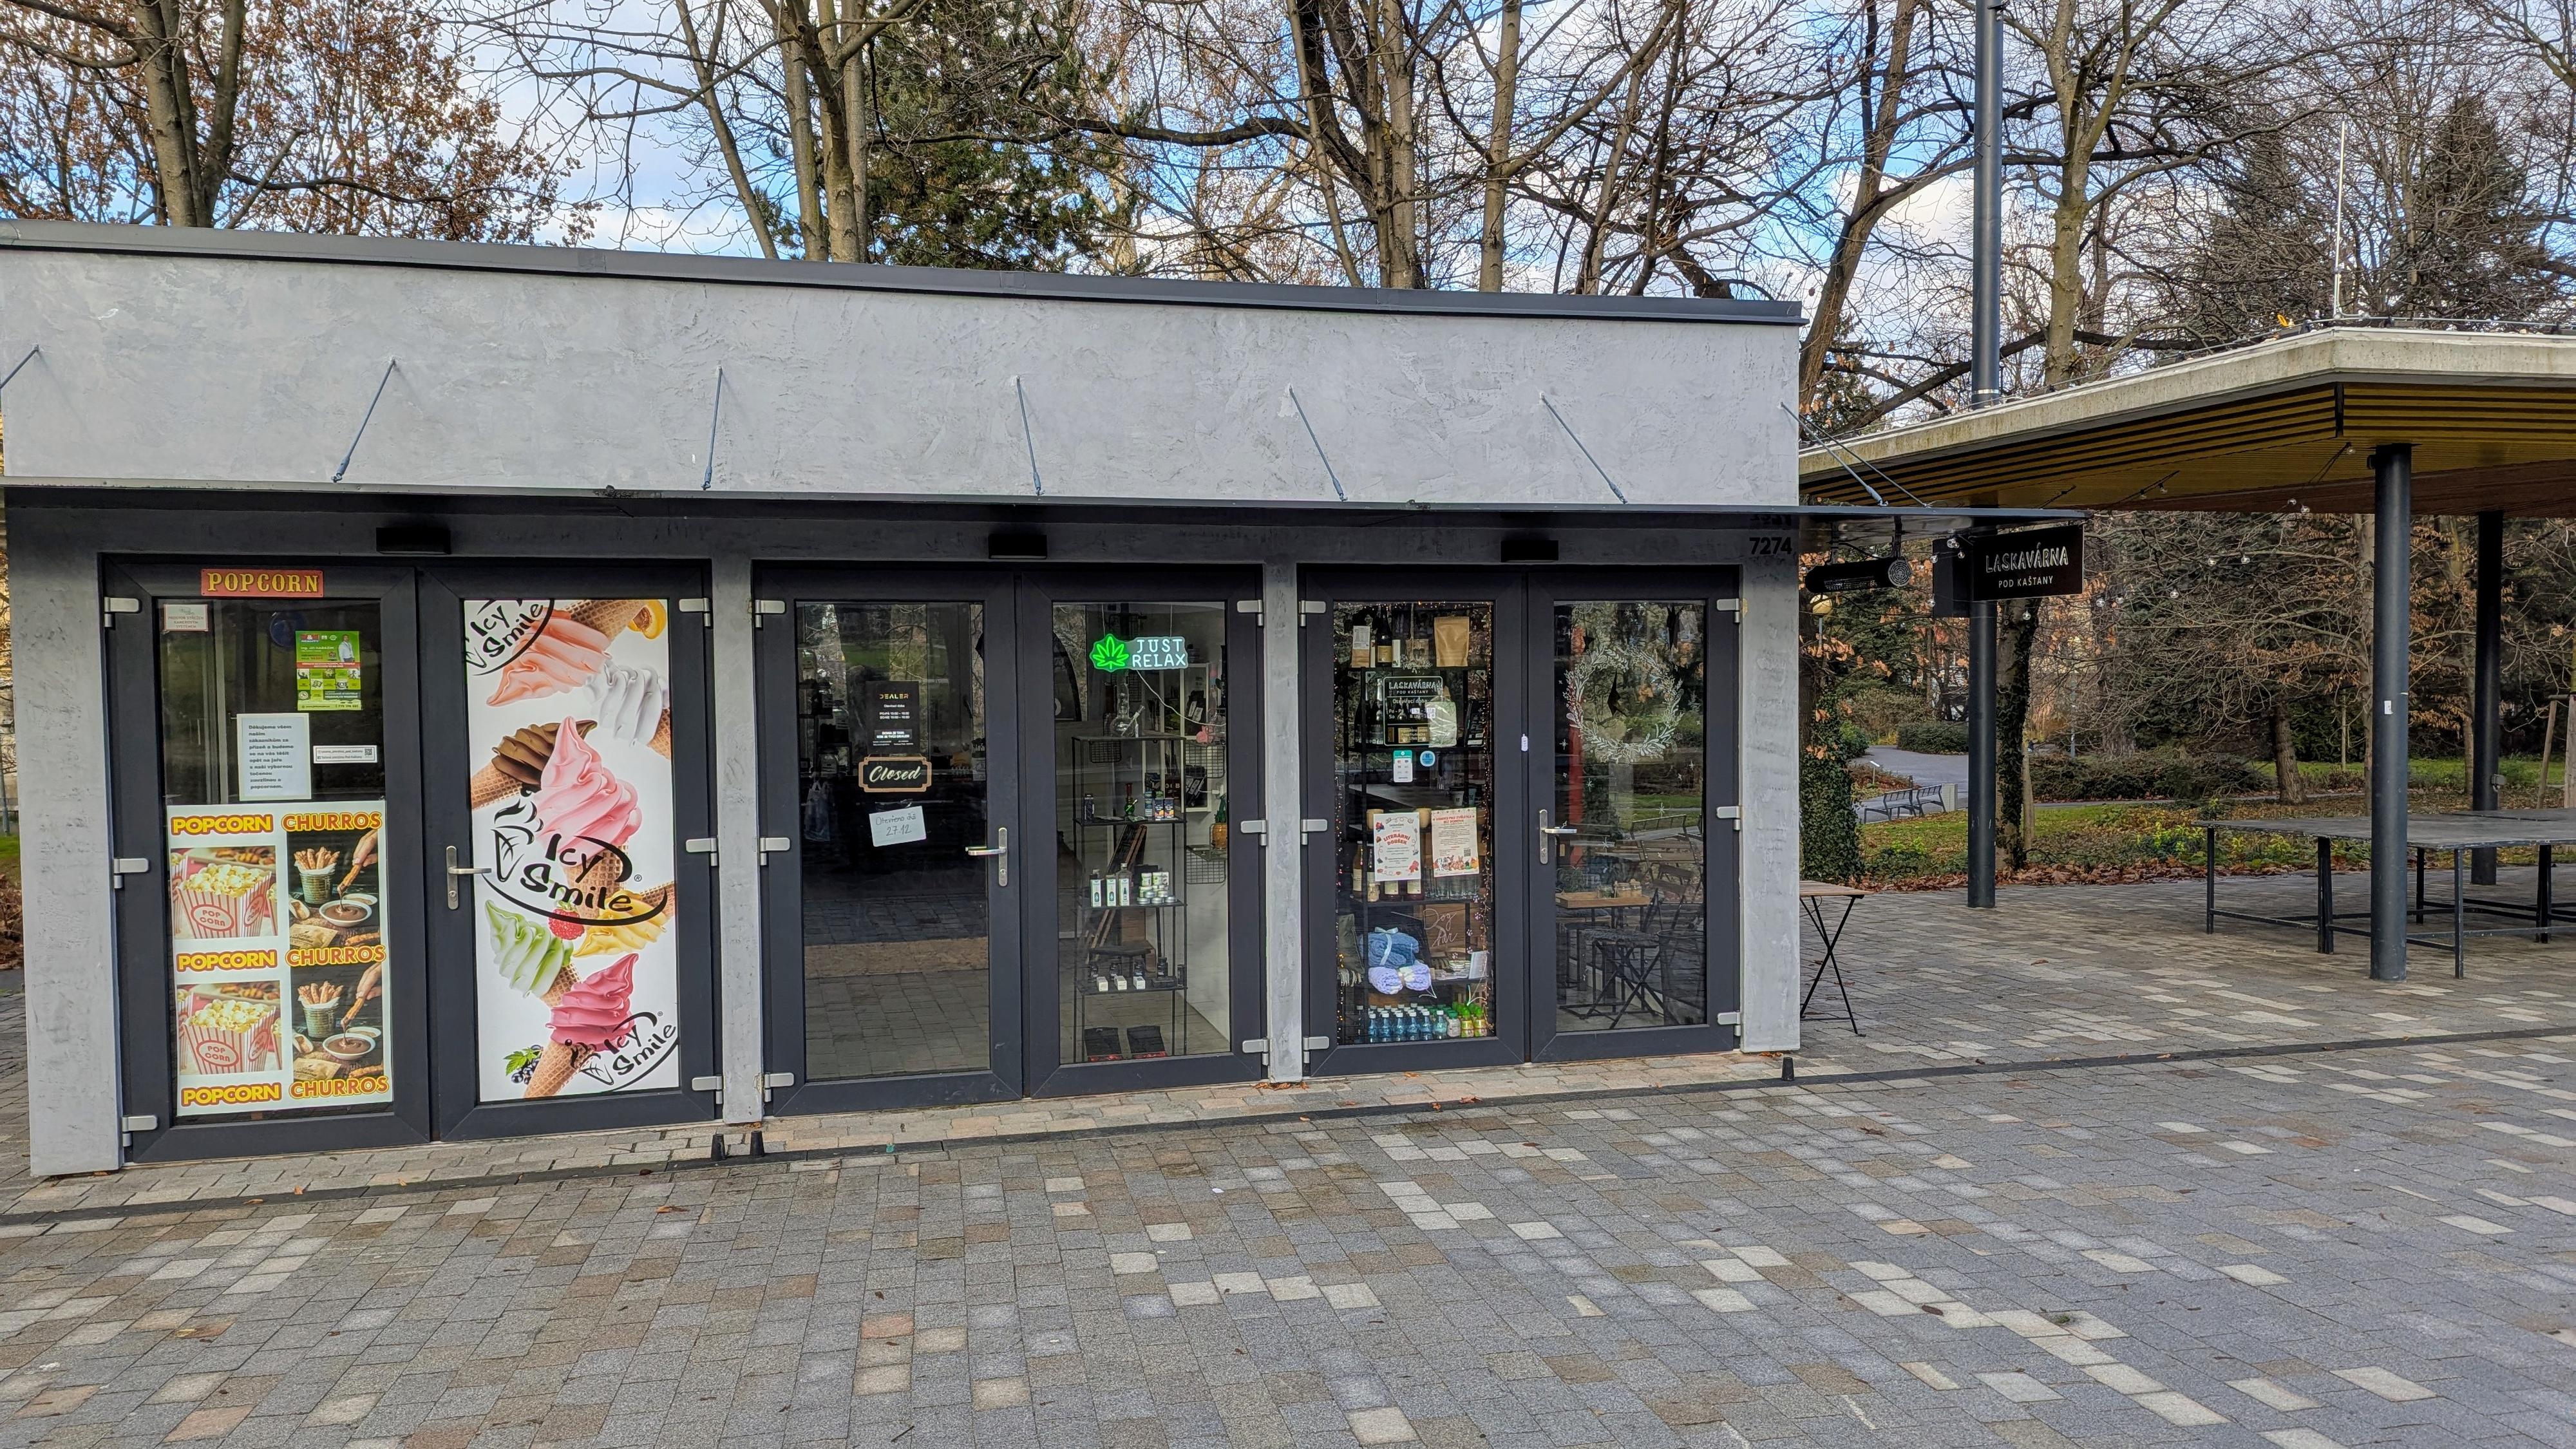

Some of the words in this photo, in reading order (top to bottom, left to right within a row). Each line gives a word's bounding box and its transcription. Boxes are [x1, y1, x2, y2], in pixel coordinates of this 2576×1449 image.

[1749, 536, 1792, 555] 7274
[1985, 542, 2069, 573] LASKAVÁRNA
[207, 572, 319, 593] POPCORN
[1998, 580, 2014, 588] POD
[2017, 576, 2054, 587] KAŠTANY
[470, 605, 510, 637] Icy
[482, 603, 544, 658] Smile
[1137, 638, 1183, 653] JUST
[1132, 654, 1186, 667] RELAX
[1388, 679, 1436, 690] LASKAVÁRNA
[869, 765, 921, 782] Closed
[171, 815, 273, 835] POPCORN
[281, 811, 382, 833] CHURROS
[545, 833, 604, 883] Icy
[520, 864, 633, 912] Smile
[200, 916, 225, 927] CORN
[202, 909, 220, 918] POP
[1423, 908, 1457, 931] Dog
[176, 950, 277, 972] POPCORN
[285, 945, 386, 966] CHURROS
[604, 1025, 641, 1054] Icy
[612, 1025, 676, 1075] Smile
[205, 1052, 231, 1062] CORN
[182, 1083, 282, 1106] POPCORN
[289, 1077, 388, 1099] CHURROS
